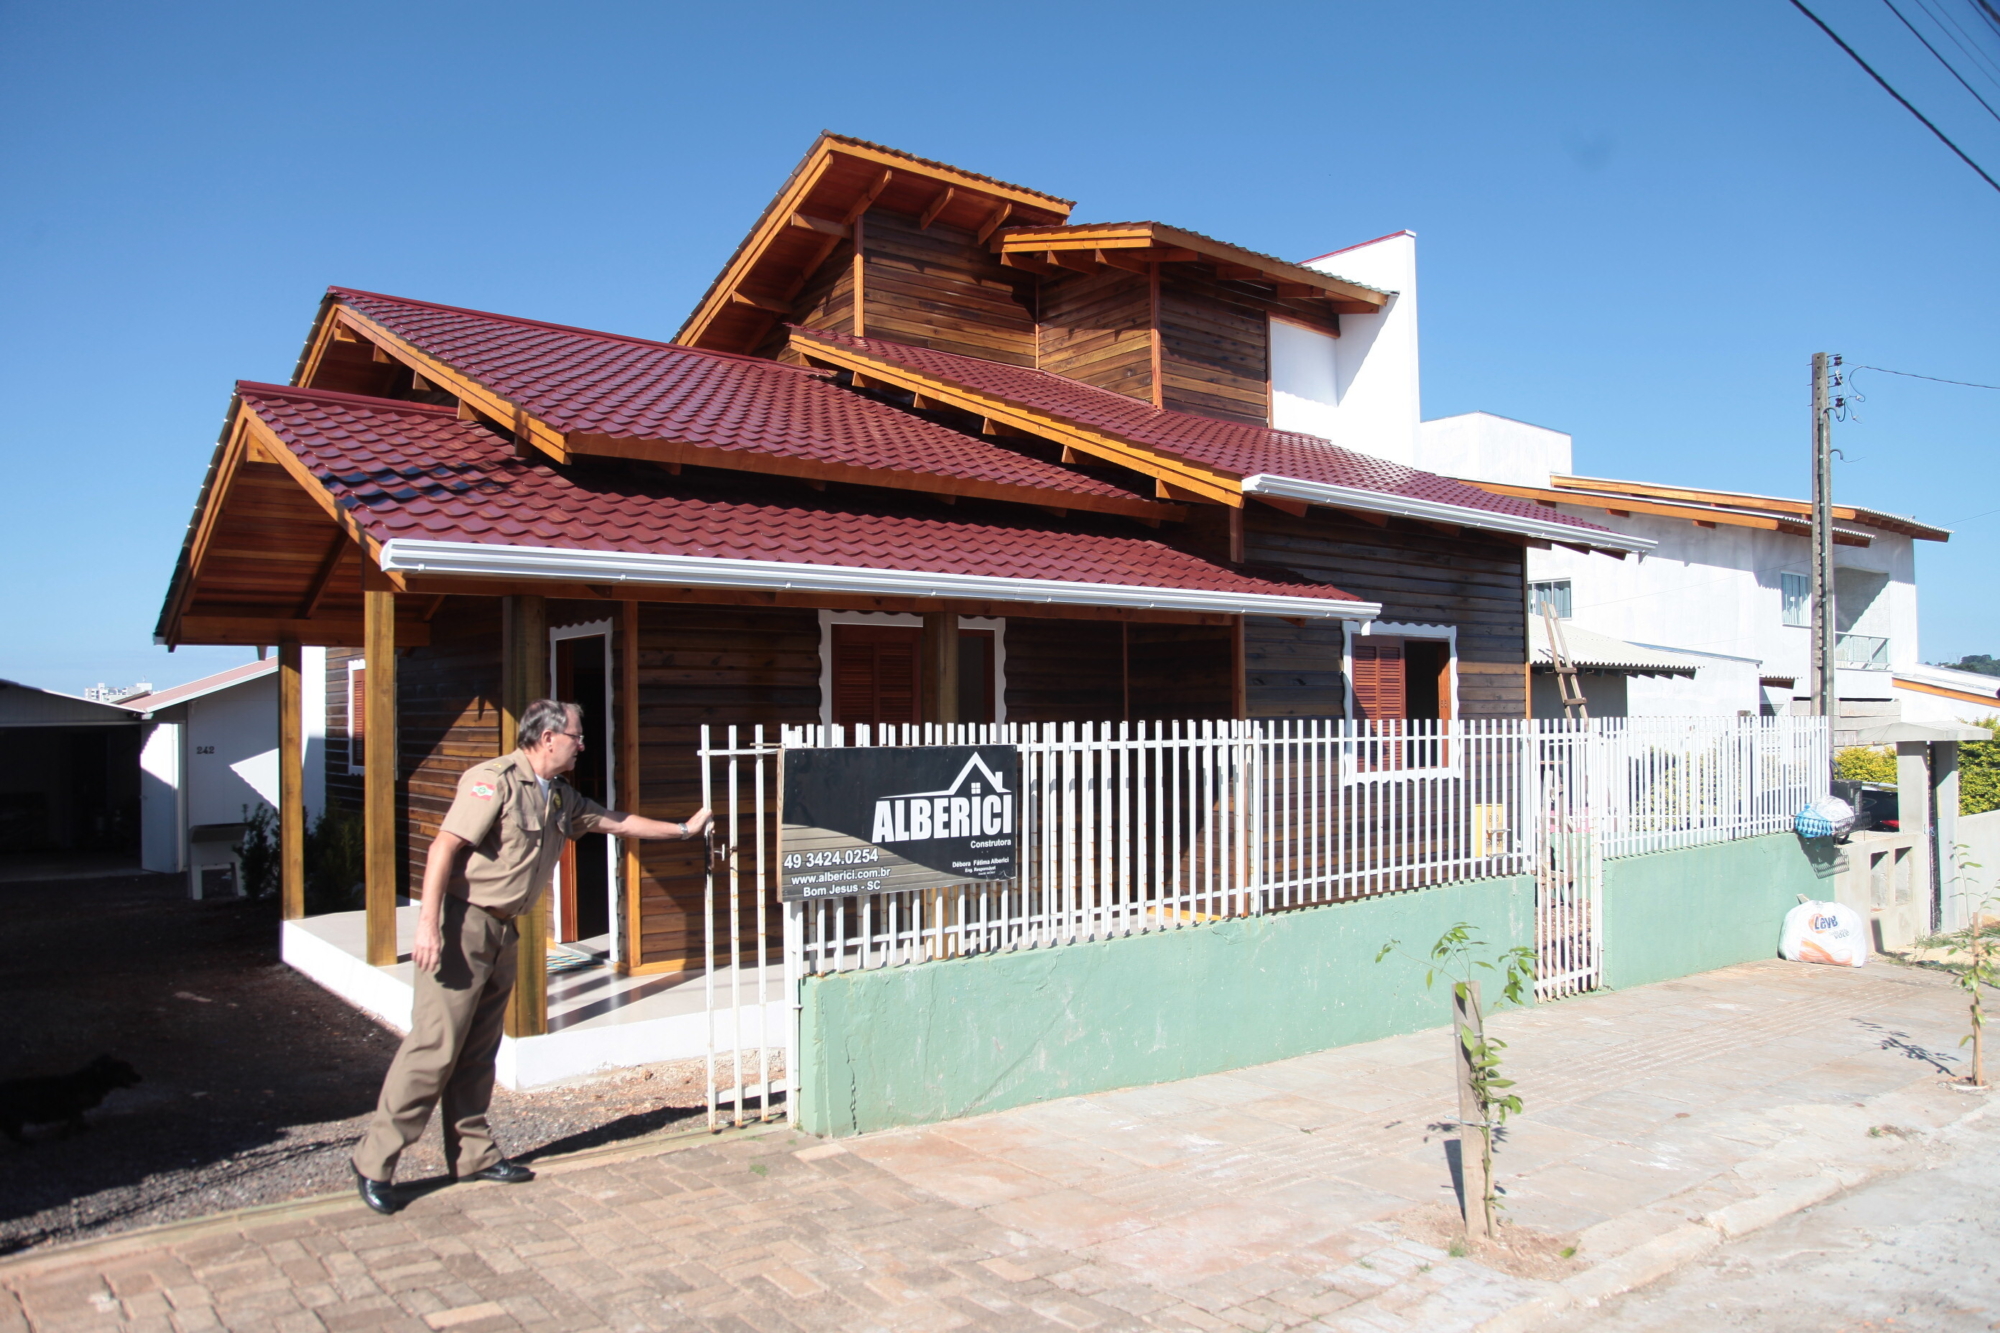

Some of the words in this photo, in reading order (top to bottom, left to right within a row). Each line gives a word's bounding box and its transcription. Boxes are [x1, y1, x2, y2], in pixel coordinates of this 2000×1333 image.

[196, 746, 215, 755] 242
[872, 794, 1012, 843] ALBERICI
[970, 838, 1012, 849] Construtora
[784, 853, 802, 869] 49
[805, 848, 879, 867] 3424.0254
[791, 867, 891, 885] www.alberici.com.br
[803, 886, 827, 897] Bom
[829, 883, 858, 894] Jesus
[867, 880, 881, 891] SC
